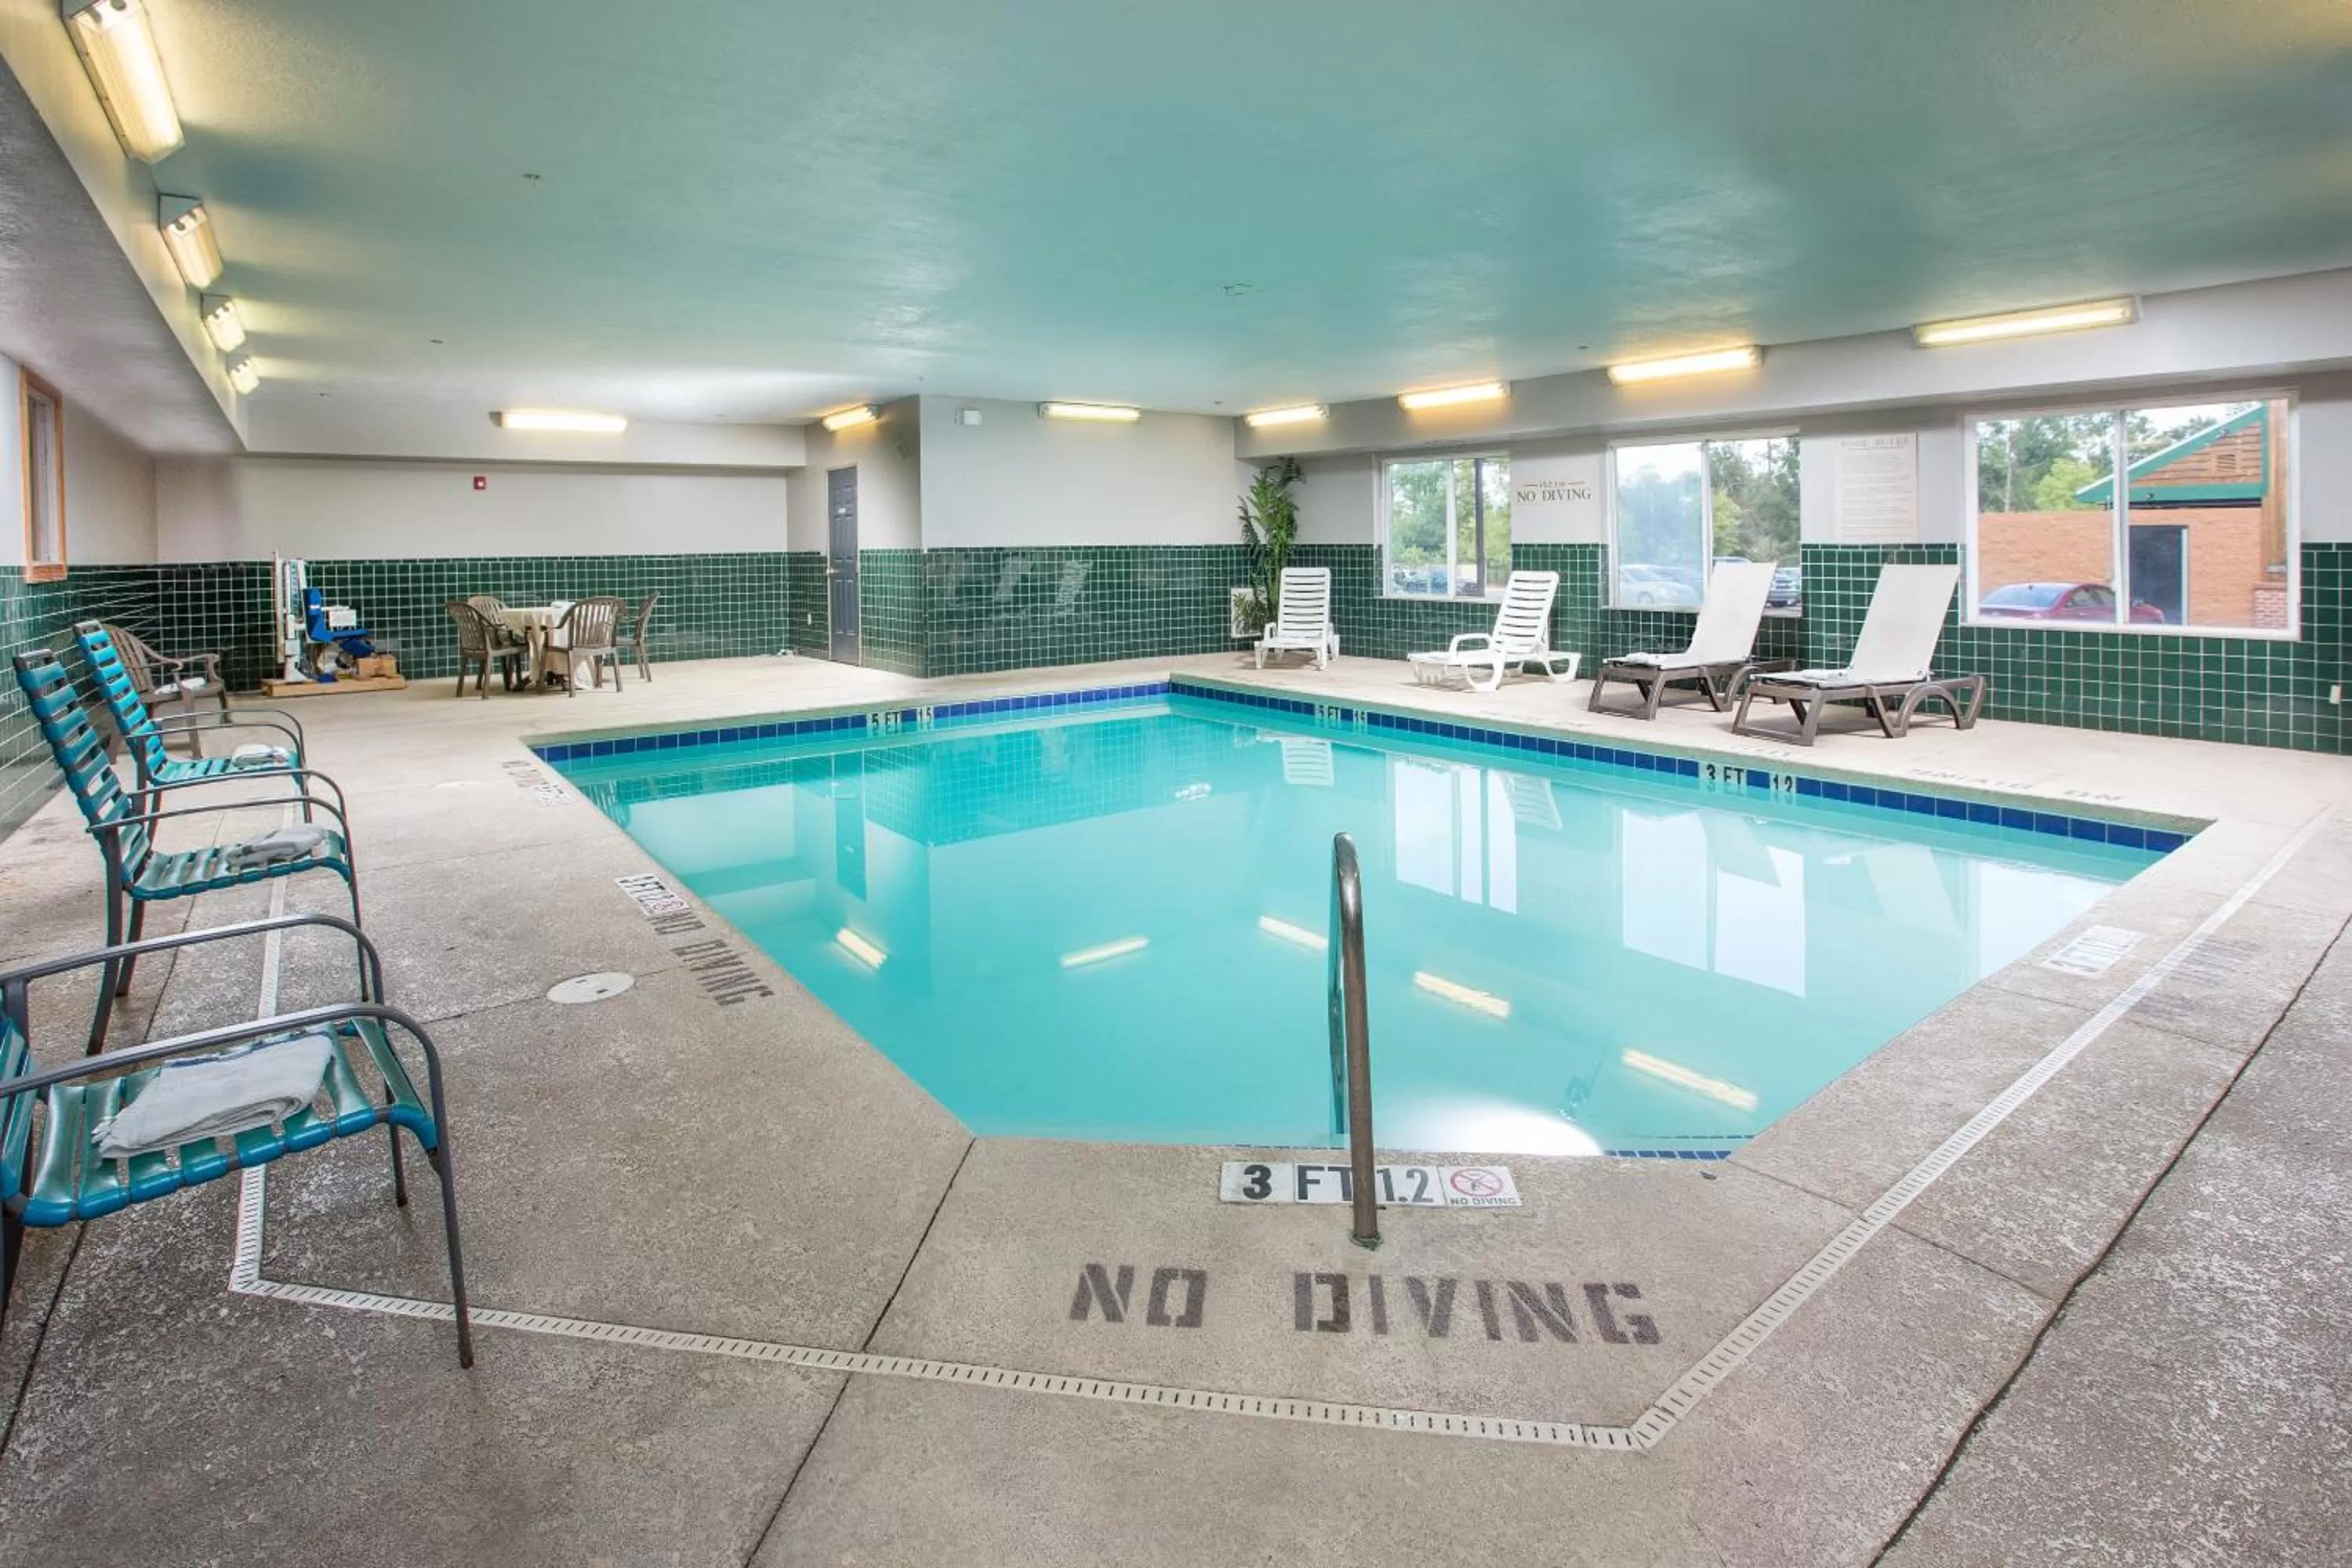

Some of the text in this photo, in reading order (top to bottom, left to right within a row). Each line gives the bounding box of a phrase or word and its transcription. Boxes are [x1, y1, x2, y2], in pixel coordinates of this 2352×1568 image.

[1517, 488, 1591, 502] NO DIVING
[884, 711, 900, 725] FT
[1706, 764, 1744, 784] 3 FT
[1243, 1165, 1272, 1200] 3
[1298, 1166, 1353, 1201] FT
[1069, 1263, 1663, 1345] NO DIVING
